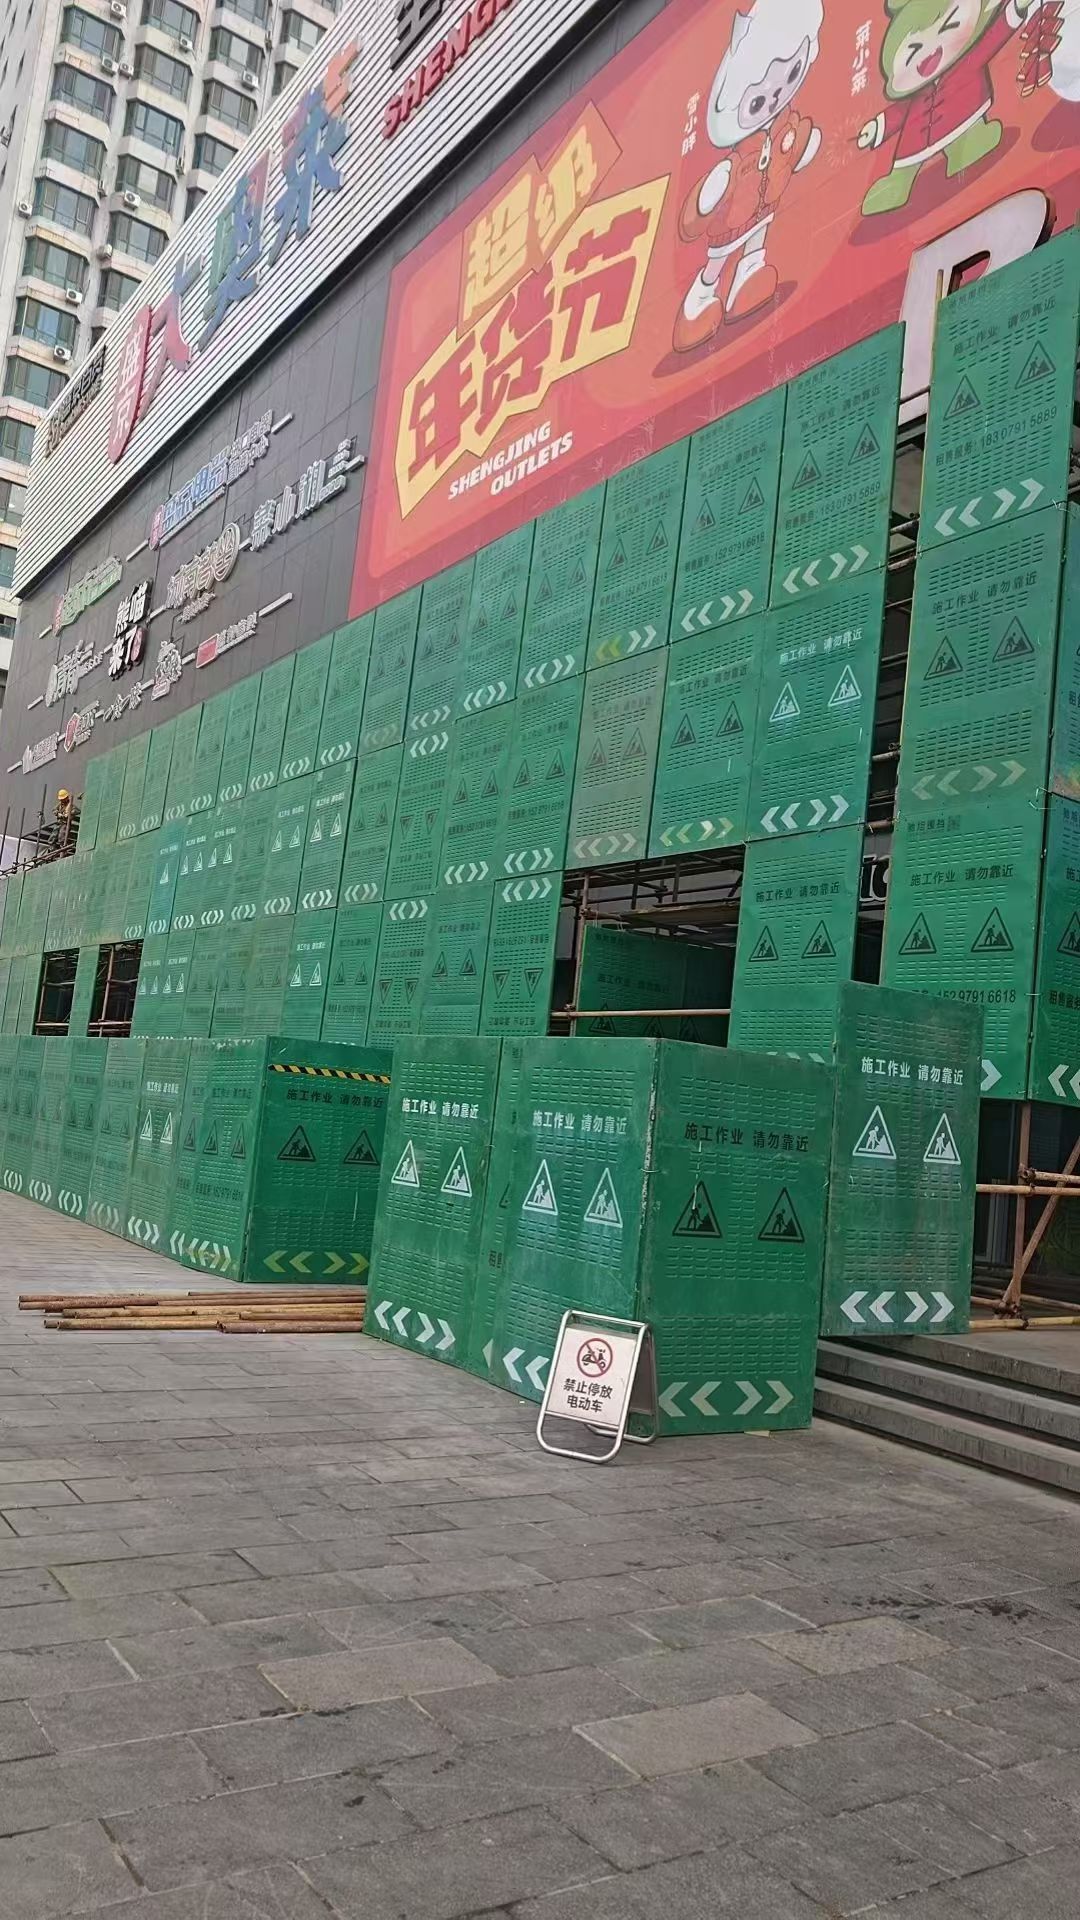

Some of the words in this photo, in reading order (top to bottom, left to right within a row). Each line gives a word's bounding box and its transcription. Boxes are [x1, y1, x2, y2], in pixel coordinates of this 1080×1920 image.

[681, 92, 700, 157] 雪小胖
[464, 124, 597, 320] 超级
[409, 205, 650, 482] 年货节
[113, 326, 145, 443] 盛京
[448, 420, 551, 500] SHENGJING
[490, 431, 574, 496] OUTLETS
[932, 590, 978, 615] 施工作业
[987, 571, 1037, 598] 请勿靠近
[909, 870, 956, 886] 施工作业
[965, 864, 1014, 881] 请勿靠近
[755, 886, 793, 903] 施工作业
[799, 882, 841, 898] 请勿靠近
[860, 1055, 911, 1079] 施工作业
[917, 1063, 963, 1086] 请勿靠近
[286, 1089, 333, 1104] 施工作业
[402, 1098, 437, 1115] 施工作业
[442, 1101, 479, 1119] 请勿靠近
[533, 1109, 575, 1130] 施工作业
[581, 1113, 627, 1135] 请勿靠近
[684, 1122, 743, 1145] 施工作业
[753, 1130, 809, 1153] 请勿靠近
[563, 1377, 613, 1399] 禁止停放
[567, 1395, 603, 1413] 电动车
